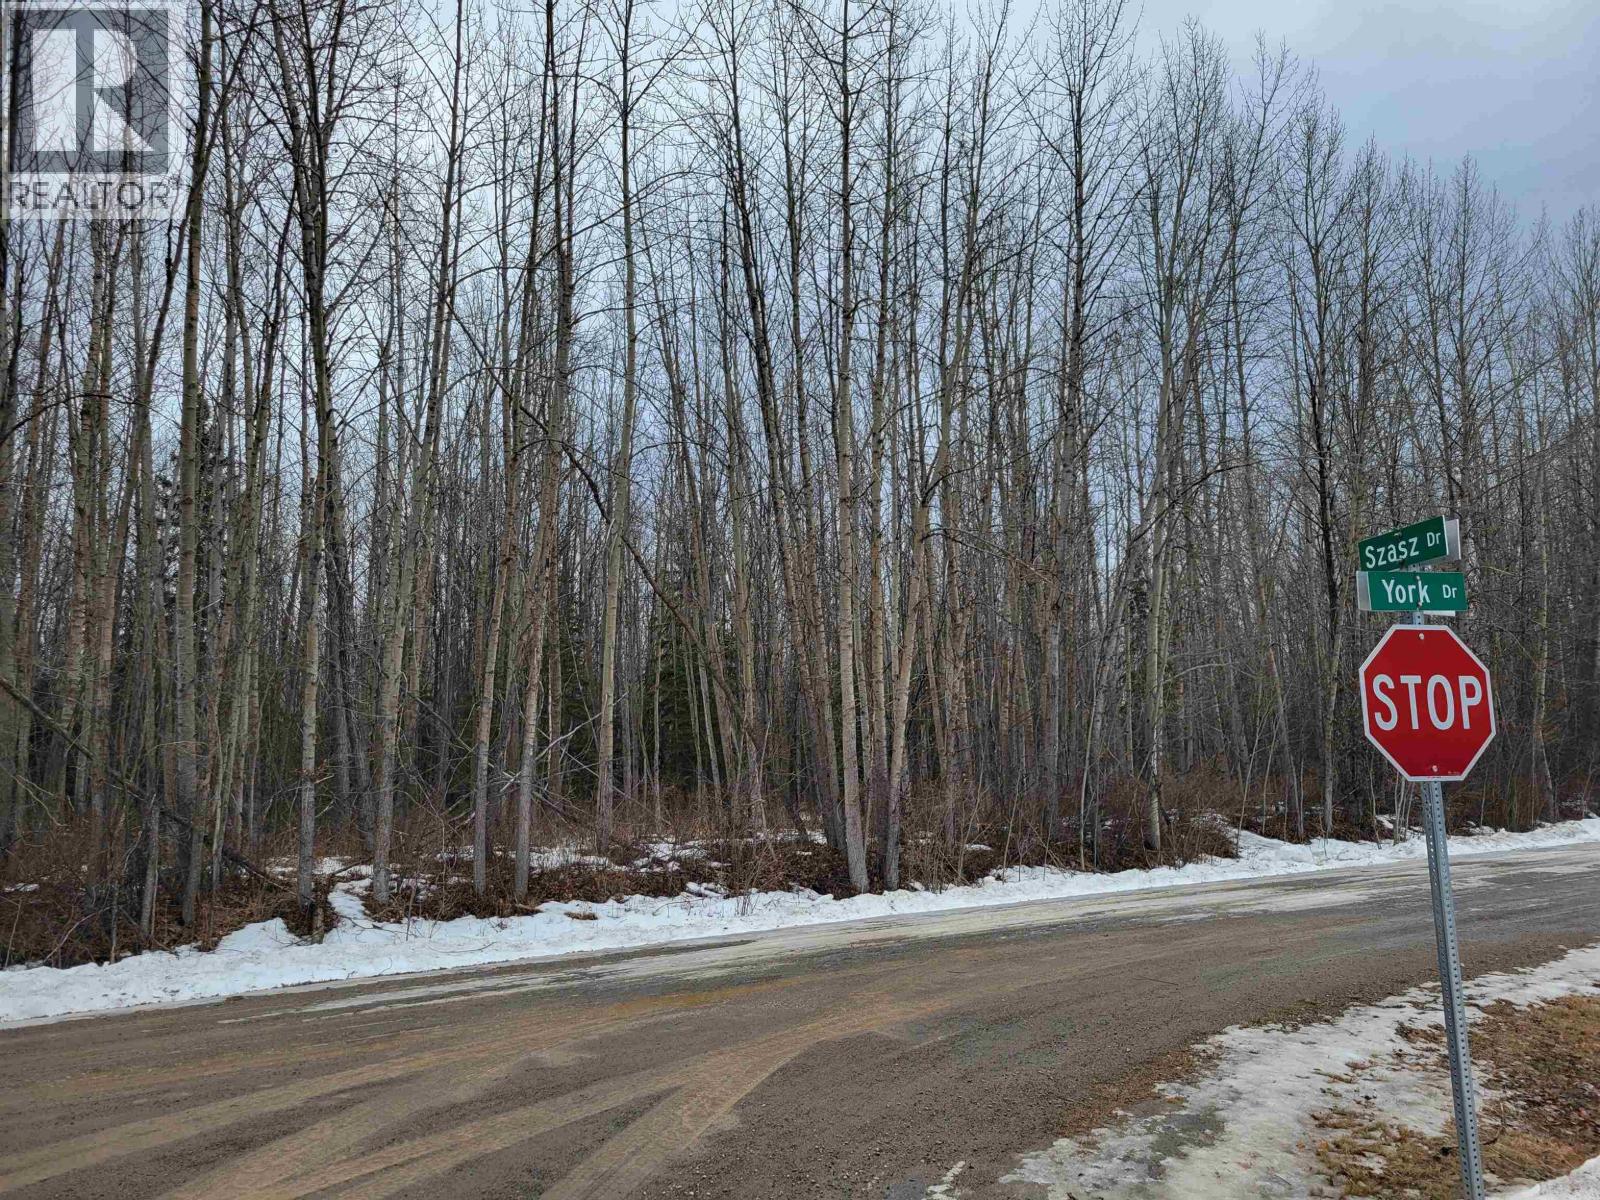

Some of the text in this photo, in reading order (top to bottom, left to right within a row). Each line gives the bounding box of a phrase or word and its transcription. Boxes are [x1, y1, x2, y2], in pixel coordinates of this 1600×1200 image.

[1365, 532, 1441, 569] Szasz Dr
[1382, 579, 1457, 604] York Dr
[1372, 674, 1482, 731] STOP
